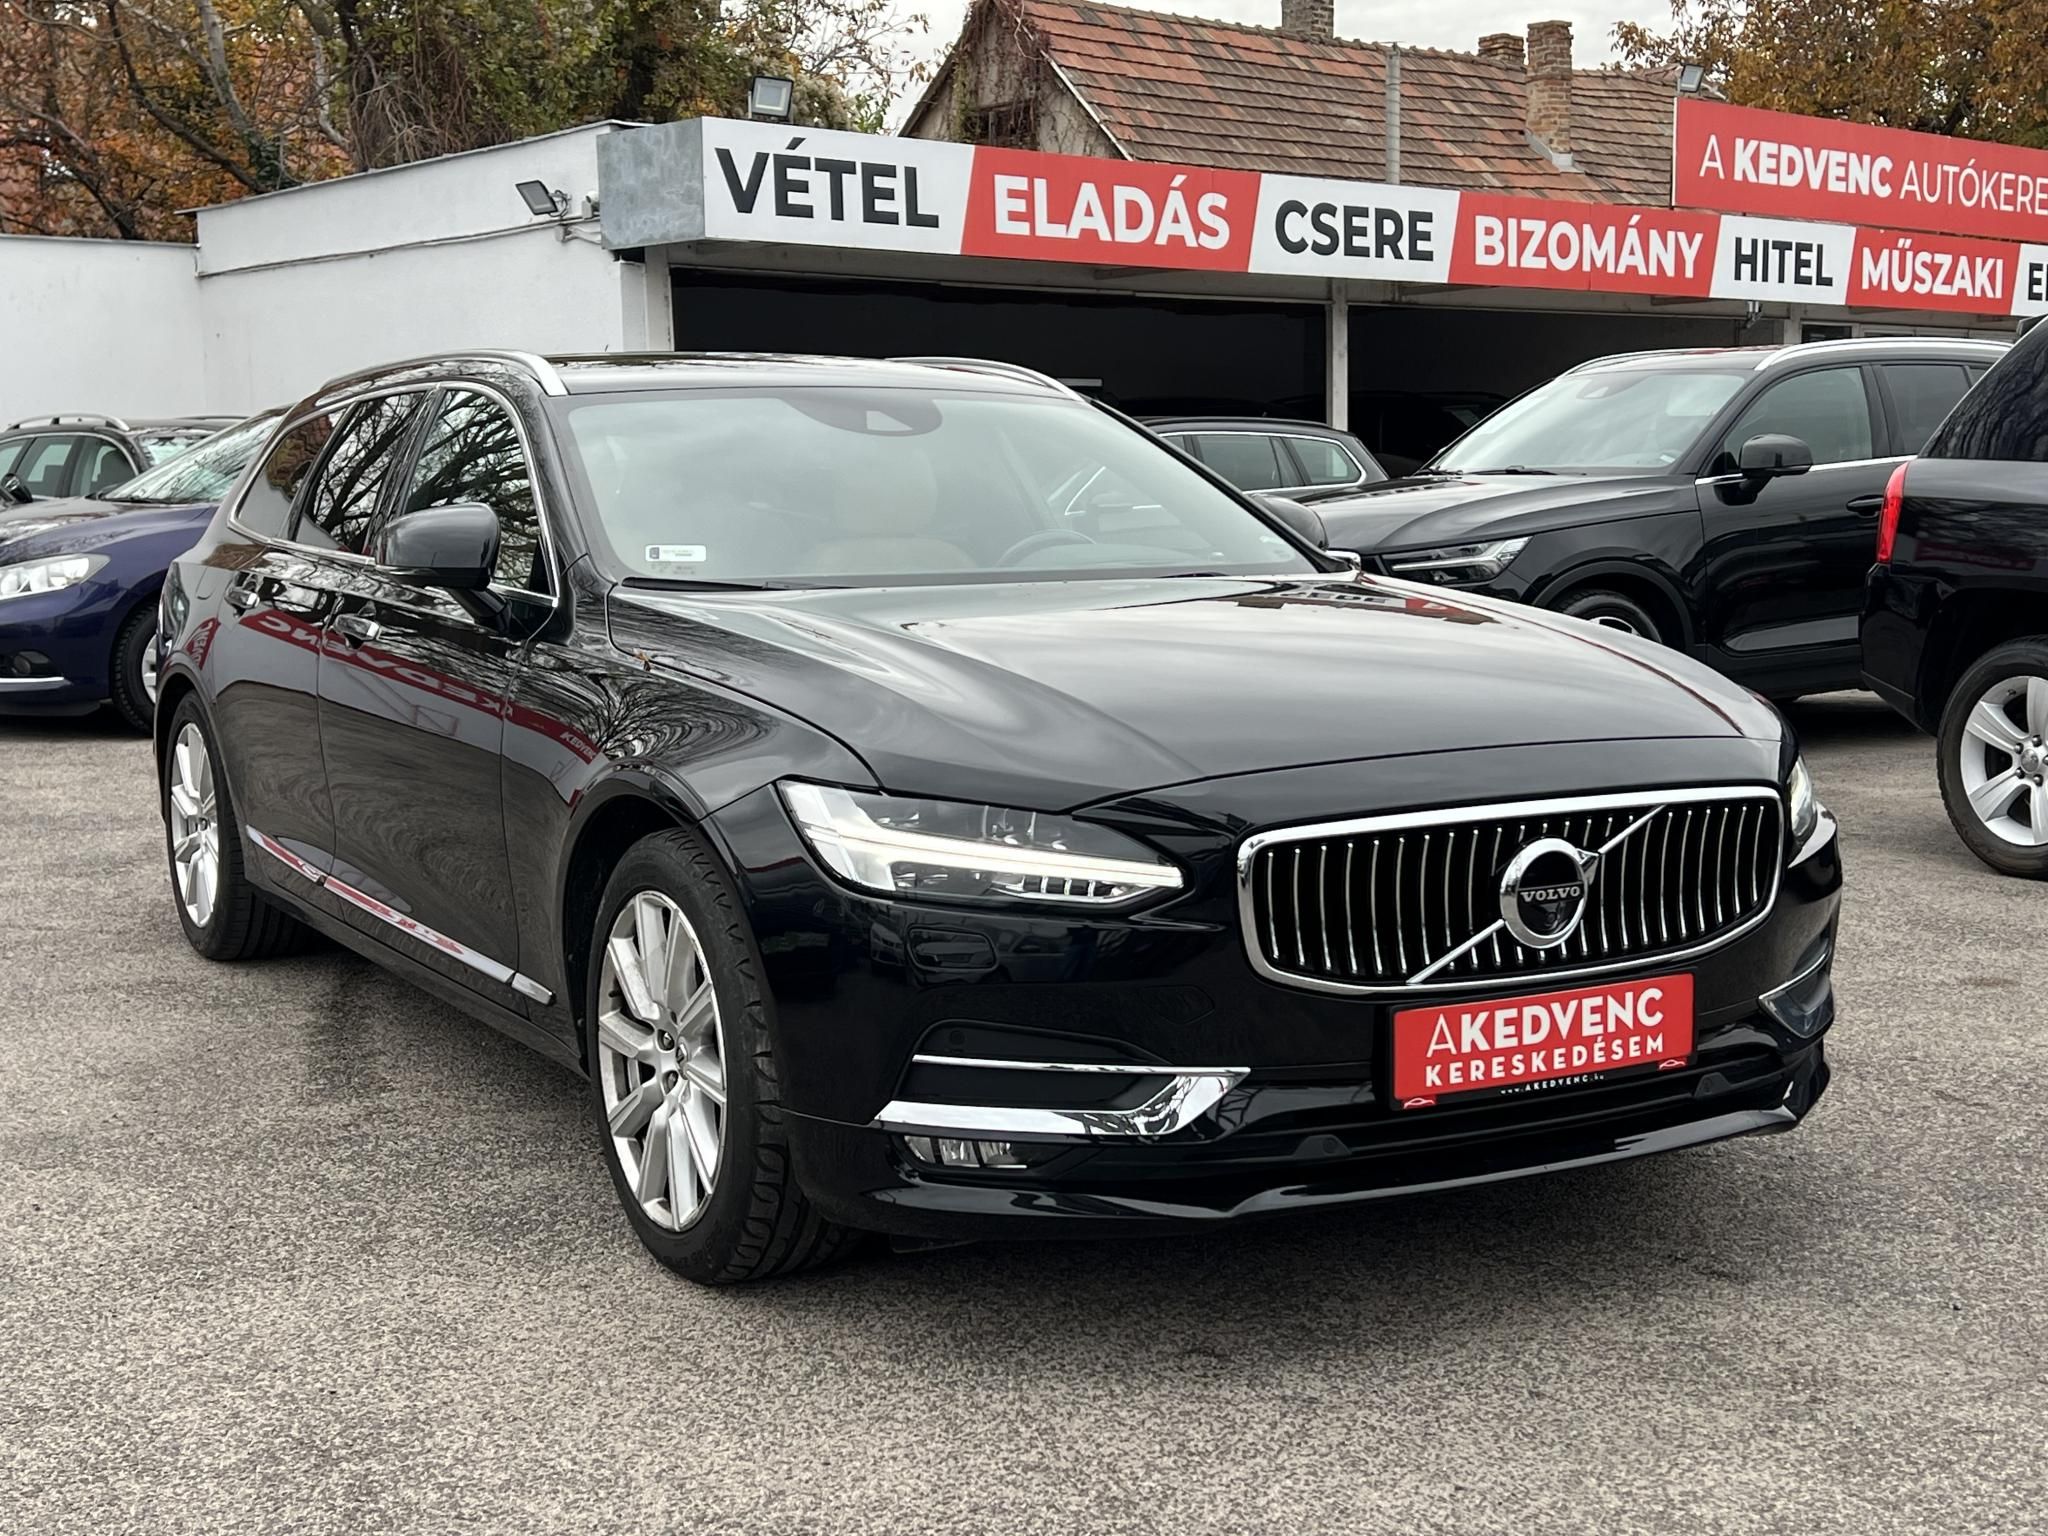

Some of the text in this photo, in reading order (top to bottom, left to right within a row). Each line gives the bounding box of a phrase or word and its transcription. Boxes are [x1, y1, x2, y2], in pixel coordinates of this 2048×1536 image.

[715, 137, 940, 229] VÉTEL
[1699, 134, 1726, 180] A
[1733, 137, 1894, 198] KEDVENC
[993, 175, 1231, 251] ELADÁS
[1275, 199, 1435, 262] CSERE
[1473, 215, 1704, 279] BIZOMÁNY
[1734, 236, 1834, 287] HITEL
[1861, 238, 2004, 299] MŰSZAKI
[2028, 262, 2048, 301] E
[1520, 886, 1580, 902] VOLVO
[1425, 1032, 1664, 1088] KERESKEDÉSEM
